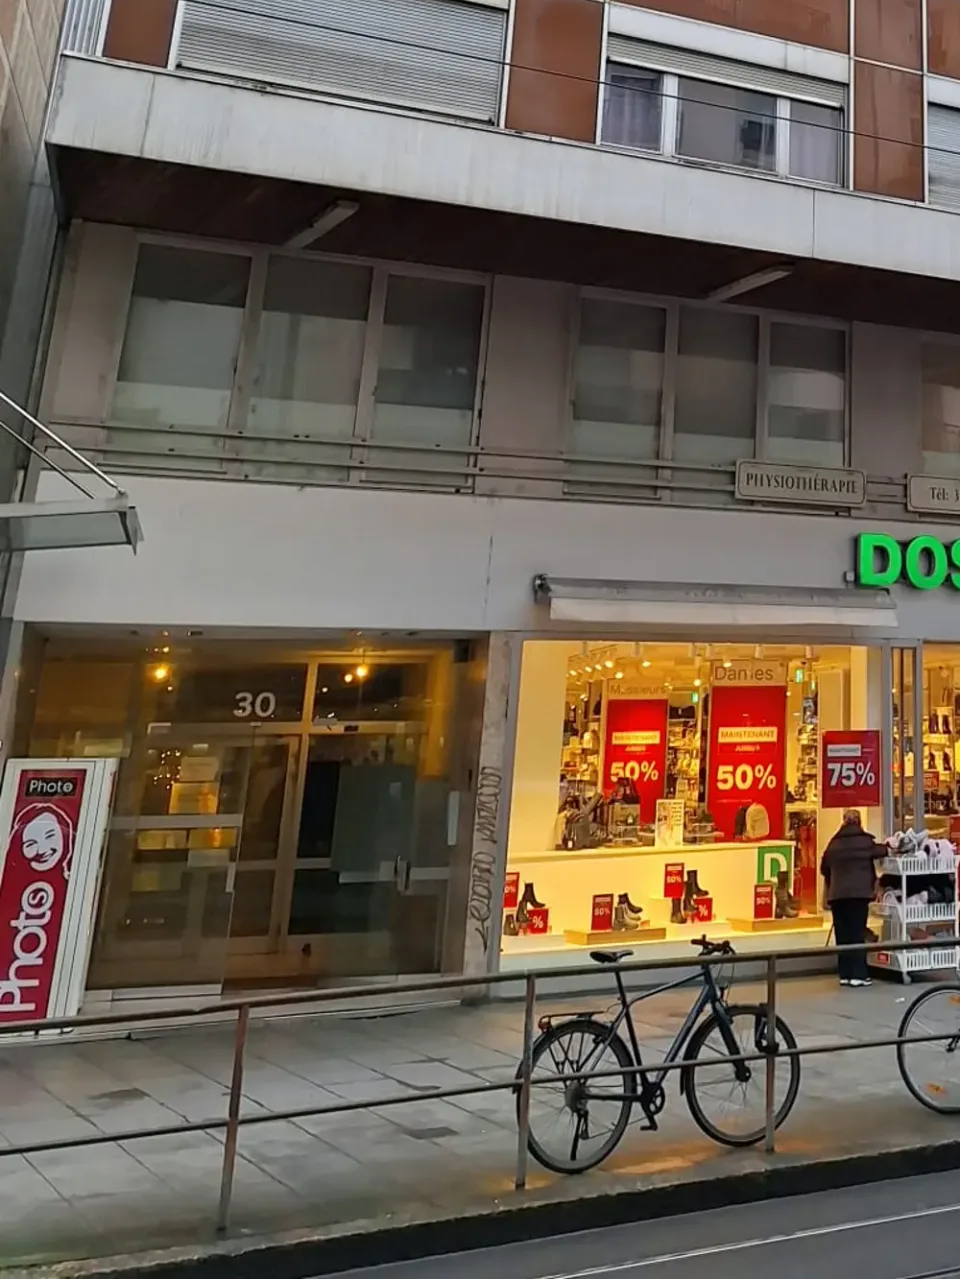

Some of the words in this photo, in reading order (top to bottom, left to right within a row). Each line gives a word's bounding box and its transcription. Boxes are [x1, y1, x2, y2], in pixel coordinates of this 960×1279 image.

[745, 472, 858, 494] PHYSIOTHÉRAPIE
[232, 691, 276, 718] 30
[720, 730, 776, 739] MAINTENANT
[610, 760, 659, 783] 50%
[715, 762, 777, 791] 50%
[826, 761, 875, 787] 75%
[28, 779, 74, 794] Photo
[763, 852, 787, 885] D
